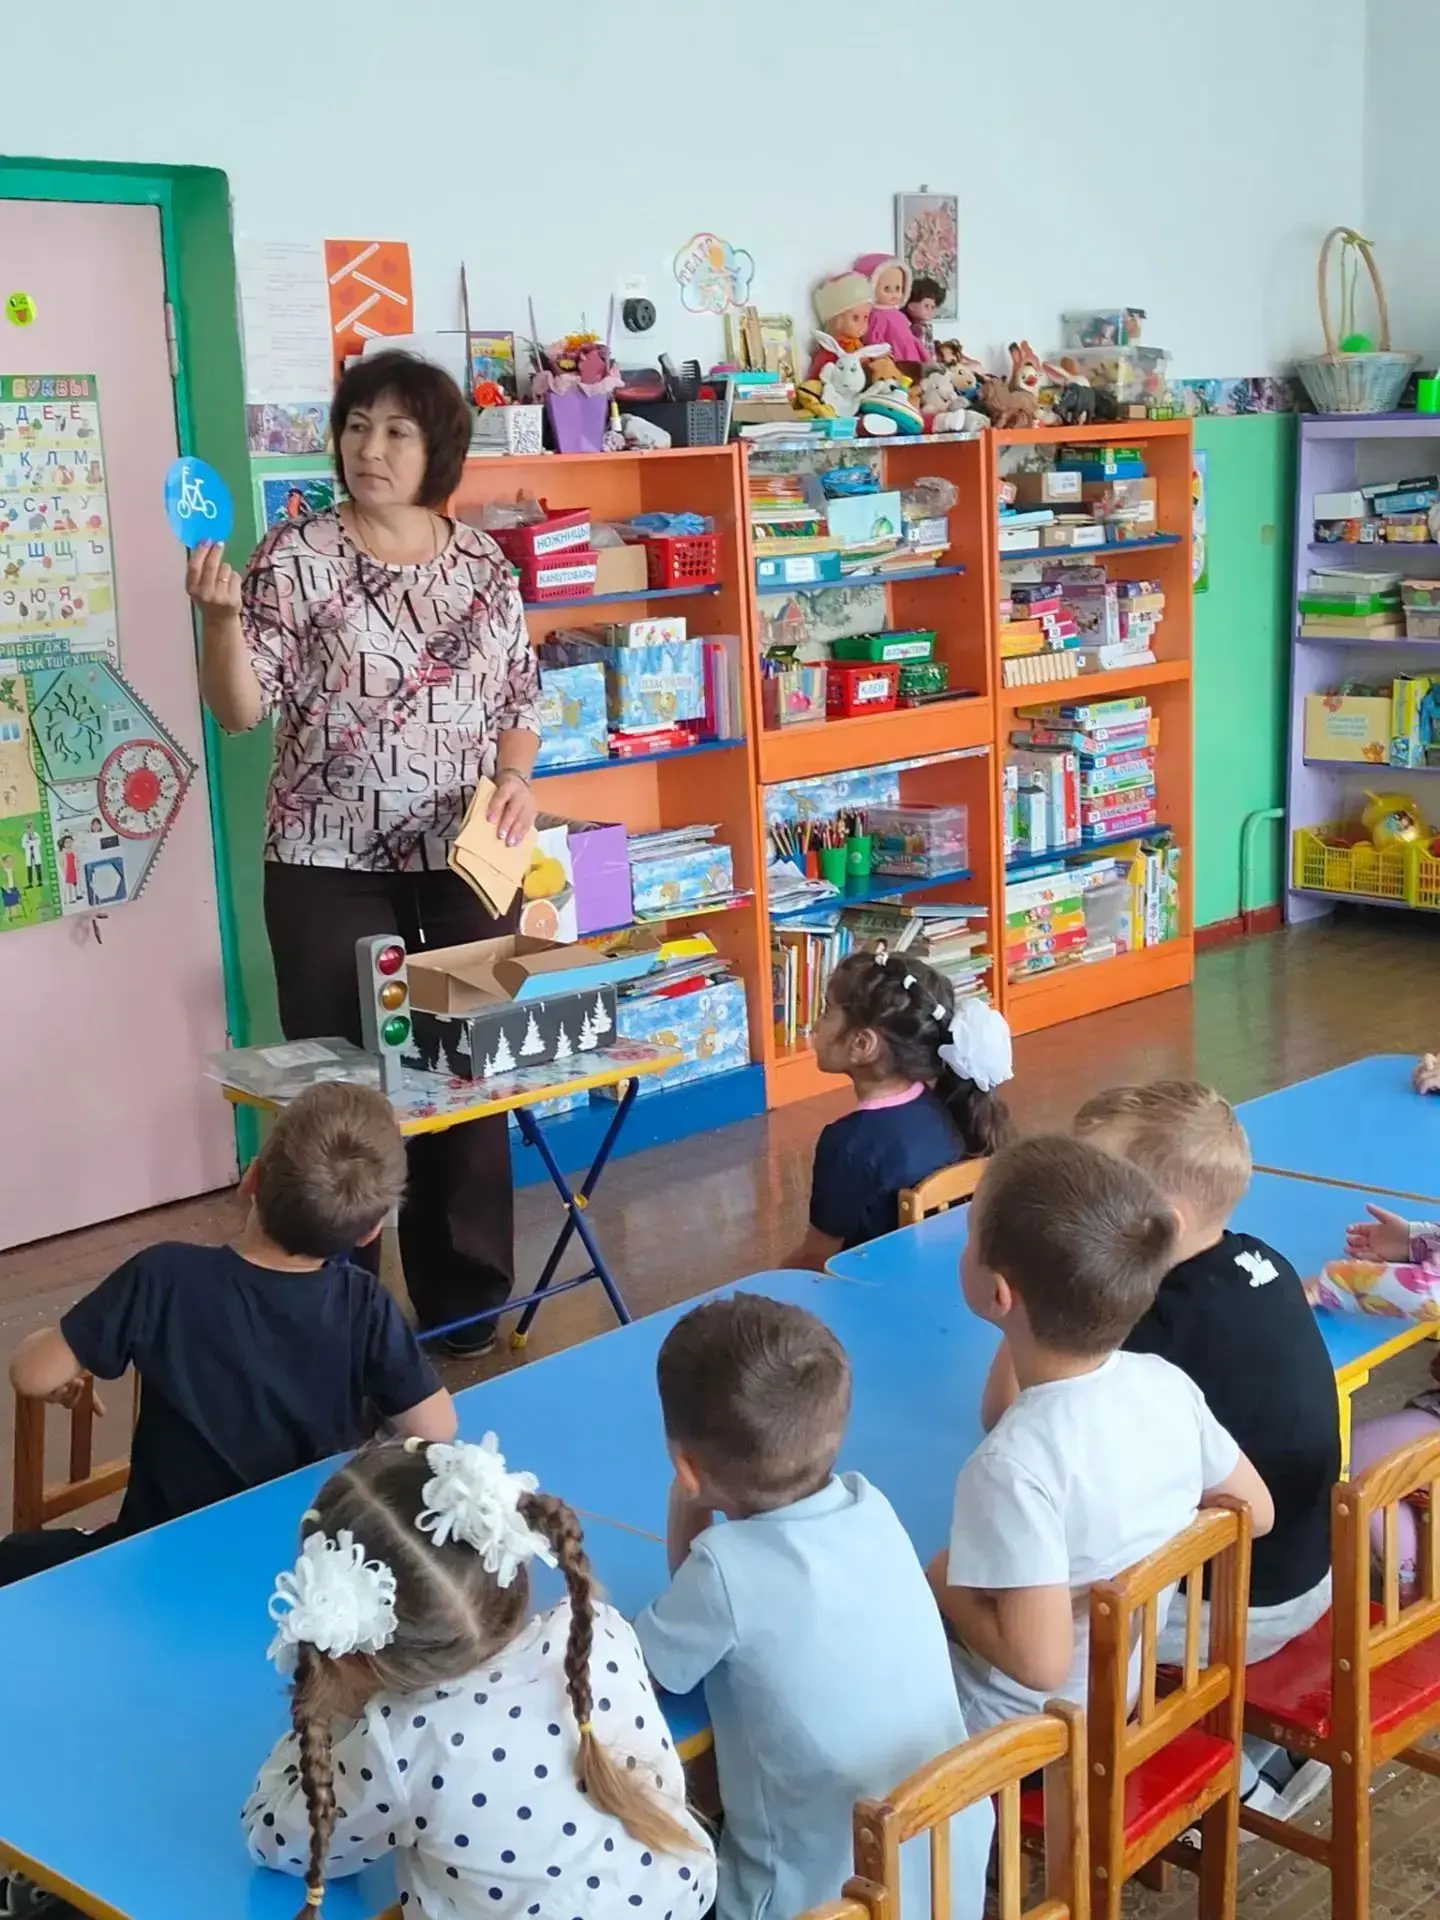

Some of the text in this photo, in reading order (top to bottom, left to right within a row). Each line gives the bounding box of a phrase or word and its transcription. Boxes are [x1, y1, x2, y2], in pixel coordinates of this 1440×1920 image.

[12, 379, 89, 398] БУКВЫ
[16, 405, 29, 424] Д
[20, 452, 32, 467] К
[46, 451, 58, 466] Л
[536, 526, 589, 549] НОЖНИЦЫ
[28, 543, 45, 557] Ш
[30, 588, 46, 603] Ю
[59, 586, 71, 601] Я
